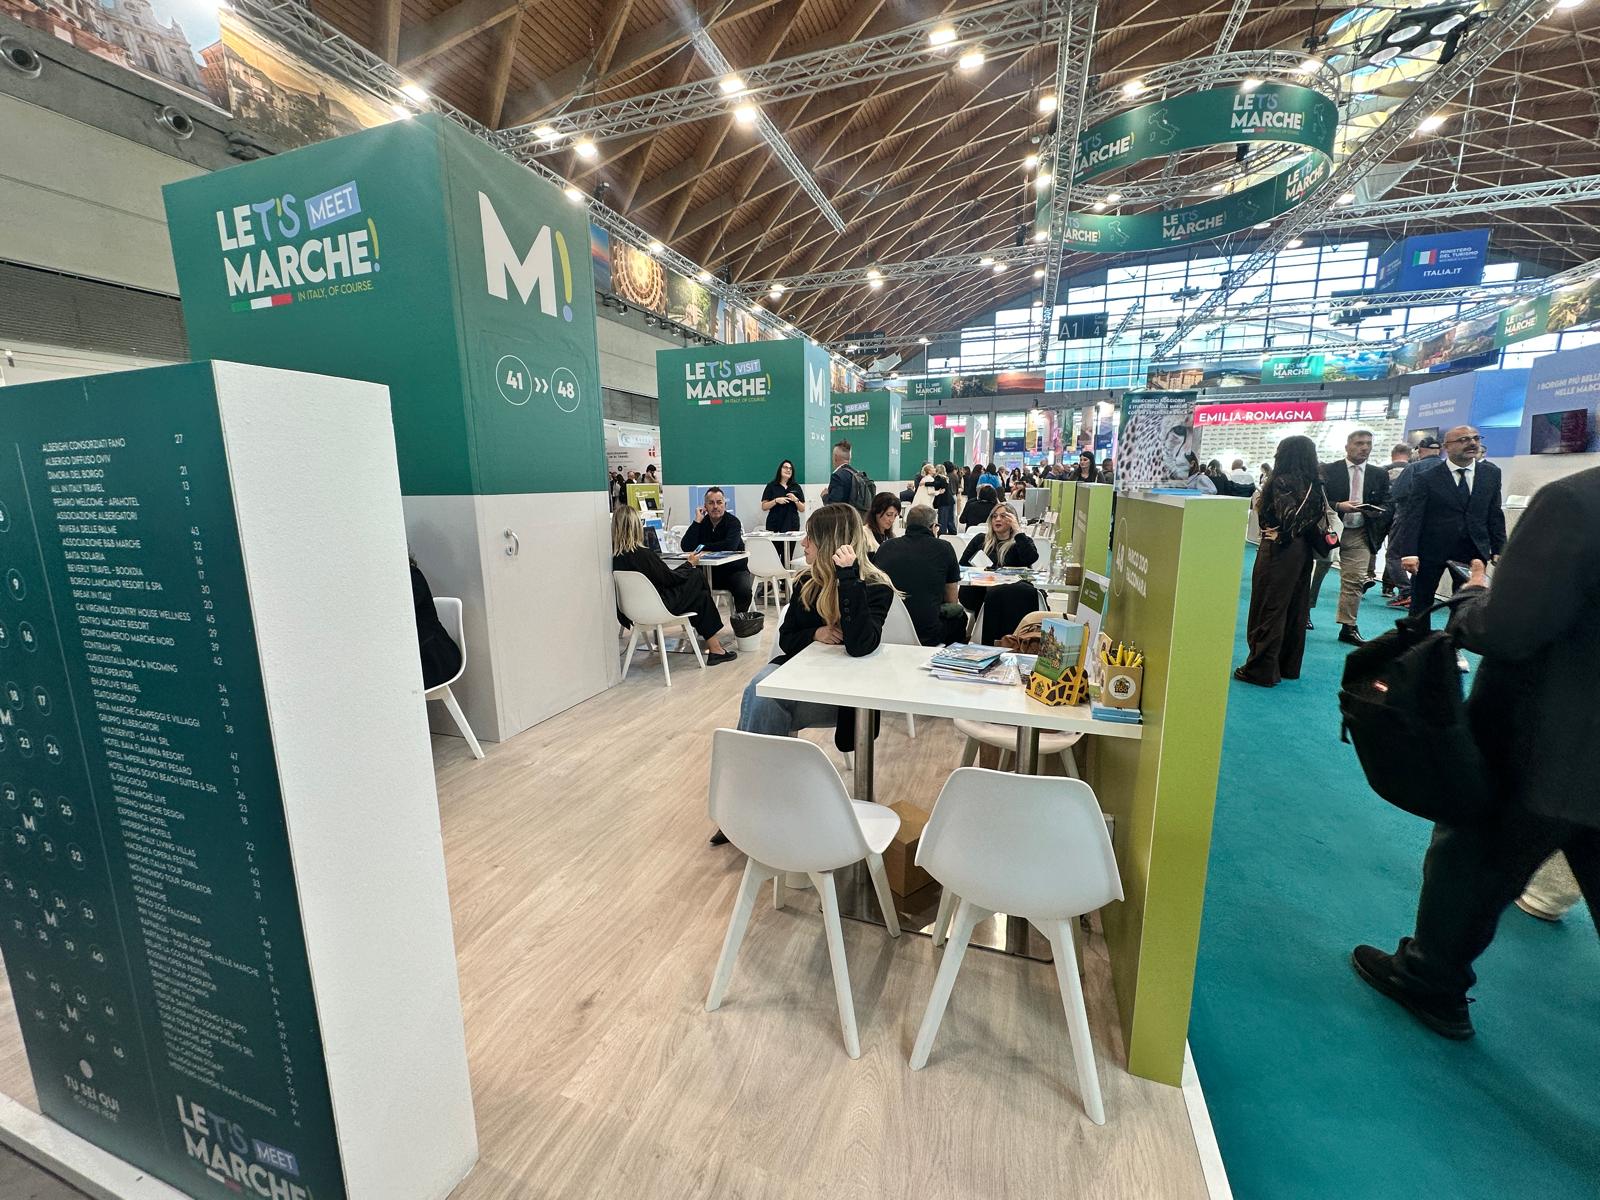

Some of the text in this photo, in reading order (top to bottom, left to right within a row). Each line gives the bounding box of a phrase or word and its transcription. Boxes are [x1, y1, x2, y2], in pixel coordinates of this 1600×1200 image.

[1232, 93, 1278, 111] LET'S
[1231, 110, 1305, 128] MARCHE!
[216, 187, 353, 251] LET'S MEET
[1162, 211, 1228, 239] MARCHE!
[1064, 228, 1101, 242] ARCHE!
[224, 218, 380, 296] MARCHE!
[1424, 268, 1462, 276] ITALIA.IT
[298, 291, 306, 302] IN
[329, 286, 339, 296] OF
[1059, 322, 1078, 339] A1
[1094, 326, 1100, 336] 4
[686, 359, 760, 380] LET'S VISIT
[1273, 368, 1312, 376] MARCHE!
[506, 370, 524, 390] 41
[558, 380, 575, 399] 48
[686, 373, 772, 400] MARCHE!
[1199, 410, 1312, 422] EMILIA-ROMAGNA
[108, 438, 126, 448] FANO
[174, 434, 183, 443] 27
[44, 455, 96, 466] ALBERGO DIFFUSO
[70, 470, 82, 478] DEL
[81, 469, 104, 478] BORGO
[179, 465, 187, 475] 21
[83, 483, 104, 492] TRAVEL
[182, 481, 189, 490] 13
[75, 497, 104, 506] WELCOME
[56, 511, 137, 519] ASSOCIAZIONE ALBERGATORI
[80, 525, 97, 533] DELLE
[190, 526, 199, 535] 43
[114, 539, 141, 548] MARCHE
[192, 541, 202, 550] 32
[195, 556, 202, 565] 16
[1116, 542, 1125, 572] 48
[198, 571, 205, 579] 17
[13, 578, 19, 590] 9
[121, 580, 144, 589] RESORT
[151, 582, 162, 590] SPA
[200, 585, 210, 594] 30
[96, 591, 112, 600] ITALY
[203, 600, 213, 609] 20
[137, 608, 158, 618] HOUSE
[158, 610, 191, 621] WELLNESS
[205, 614, 215, 623] 45
[23, 630, 32, 642] 16
[208, 629, 217, 638] 29
[155, 636, 175, 646] NORD
[211, 642, 219, 651] 39
[213, 657, 222, 665] 42
[217, 684, 226, 693] 34
[38, 695, 46, 706] 17
[20, 737, 31, 749] 23
[48, 743, 59, 755] 24
[229, 751, 238, 760] 47
[231, 765, 239, 773] 10
[32, 797, 44, 808] 26
[61, 804, 72, 816] 25
[22, 814, 36, 831] M
[245, 842, 254, 851] 22
[71, 850, 83, 862] 32
[99, 1093, 120, 1112] QUI
[176, 1095, 292, 1170] LET'S MEET
